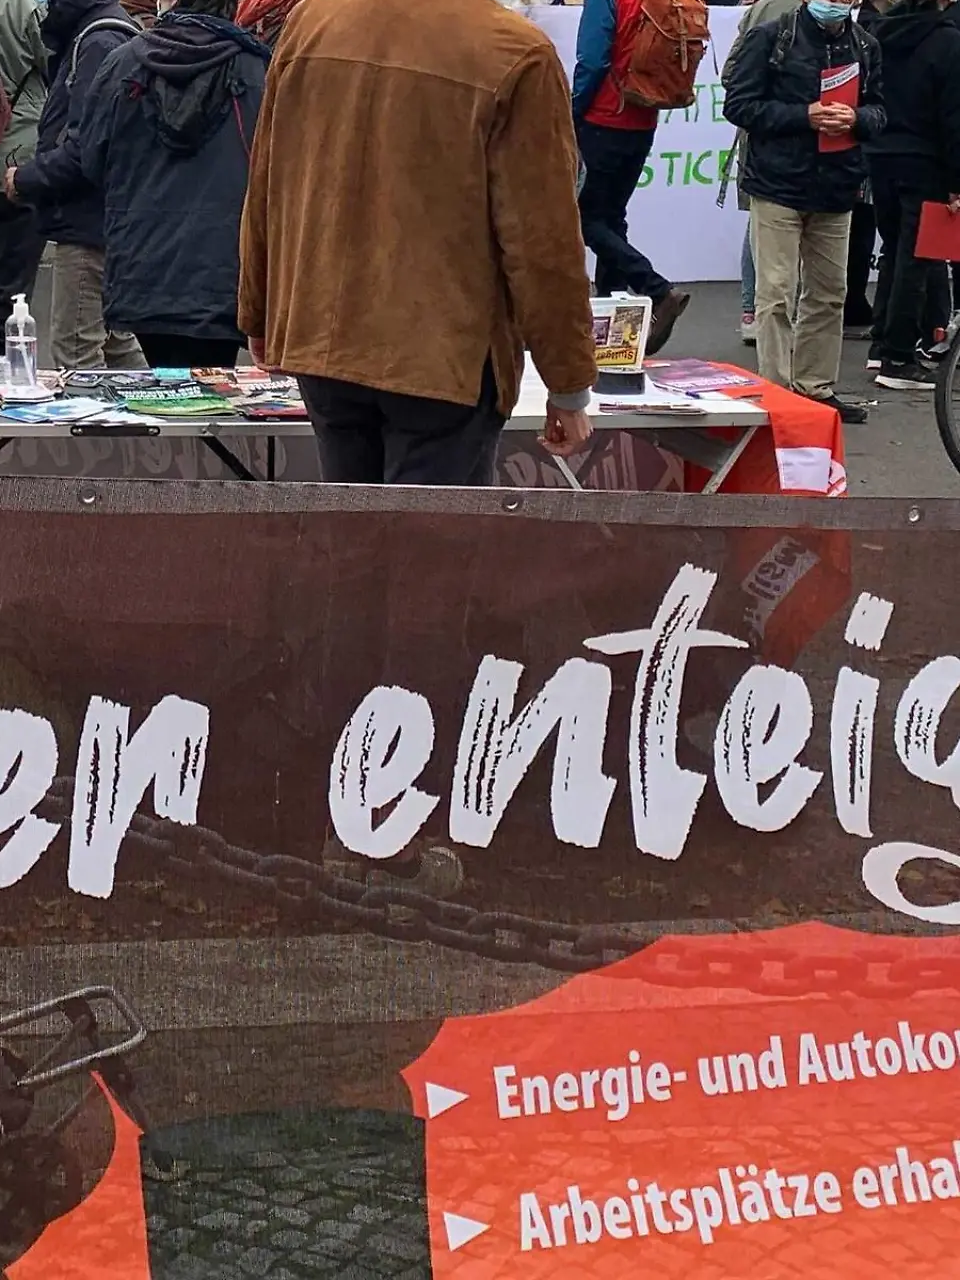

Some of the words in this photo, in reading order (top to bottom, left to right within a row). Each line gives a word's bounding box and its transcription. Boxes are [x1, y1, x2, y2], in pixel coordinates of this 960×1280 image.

[637, 150, 738, 188] STICE
[328, 562, 960, 925] enteig
[493, 1049, 687, 1122] Energie-
[697, 1035, 788, 1097] und
[798, 1021, 960, 1086] Autoko
[519, 1164, 841, 1252] Arbeitsplätze
